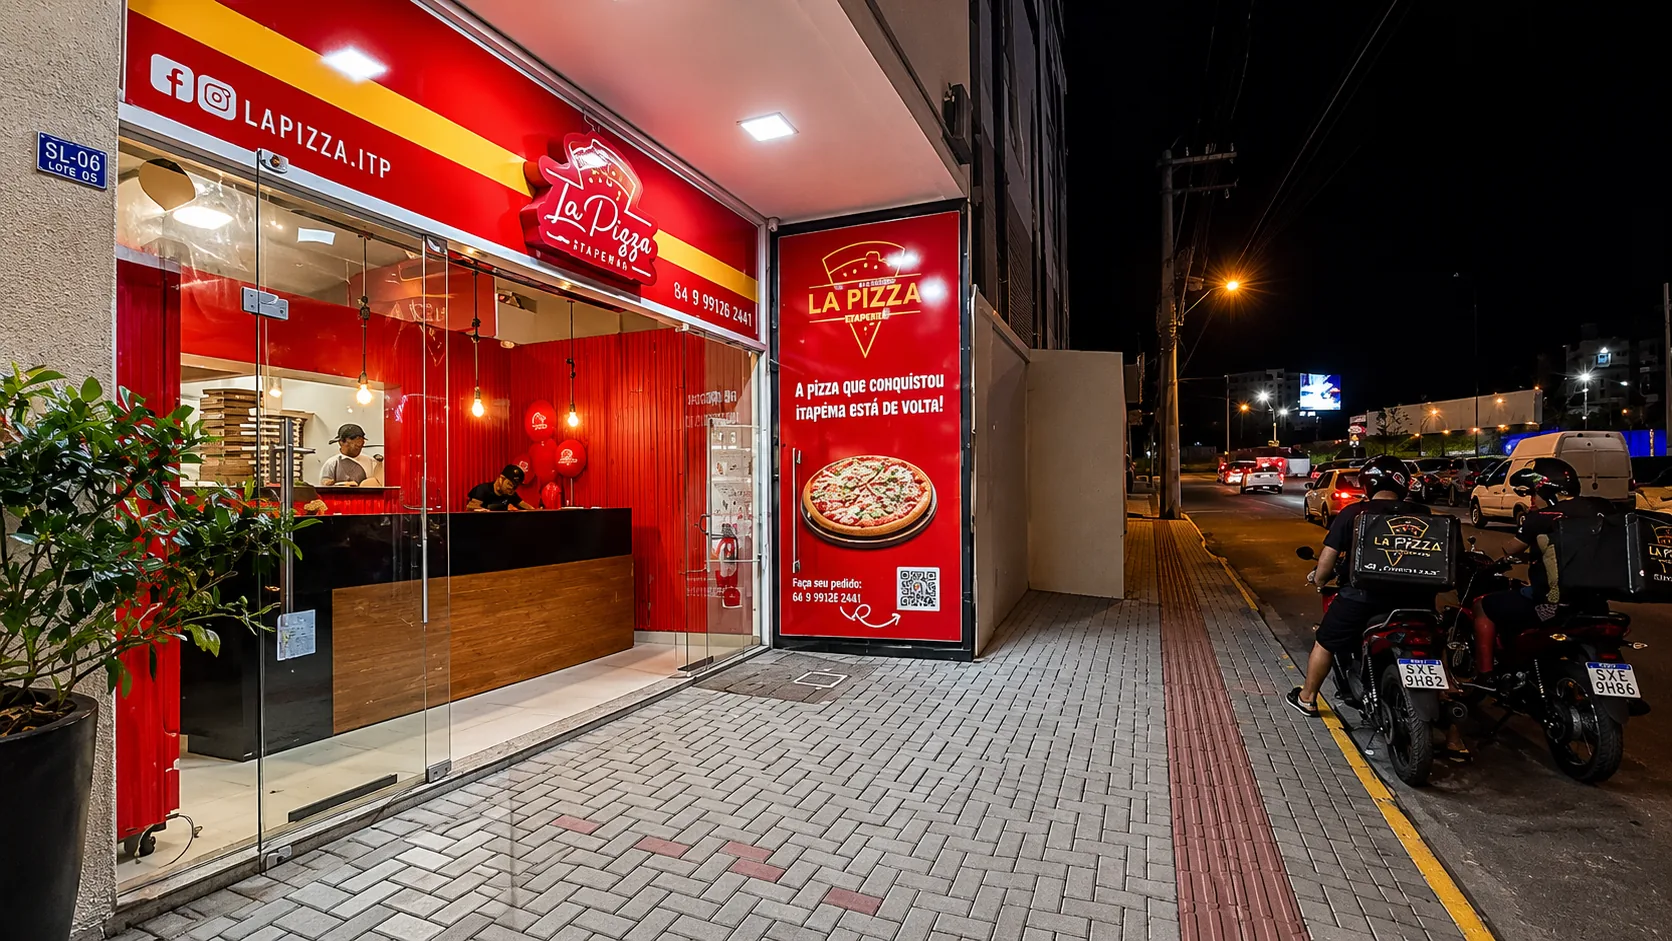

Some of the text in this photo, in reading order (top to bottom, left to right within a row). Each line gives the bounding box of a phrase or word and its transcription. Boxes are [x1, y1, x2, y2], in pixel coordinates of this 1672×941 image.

[244, 99, 391, 178] LAPIZZA.ITP
[45, 142, 100, 172] SL-06
[48, 161, 76, 177] LOTE
[543, 182, 652, 262] La Pizza
[808, 282, 922, 315] LA PIZZA
[692, 289, 699, 306] 9
[702, 293, 730, 318] 99126
[732, 306, 752, 327] 2441
[795, 382, 804, 397] A
[882, 401, 899, 415] DE
[901, 395, 944, 414] VOLTA!
[1374, 536, 1389, 546] LA
[792, 577, 862, 590] Faça seu pedido:
[806, 592, 811, 602] 9
[1406, 664, 1437, 676] SXE
[1596, 669, 1628, 682] SXE
[1405, 675, 1445, 687] 9H82
[1596, 681, 1635, 695] 9H86
